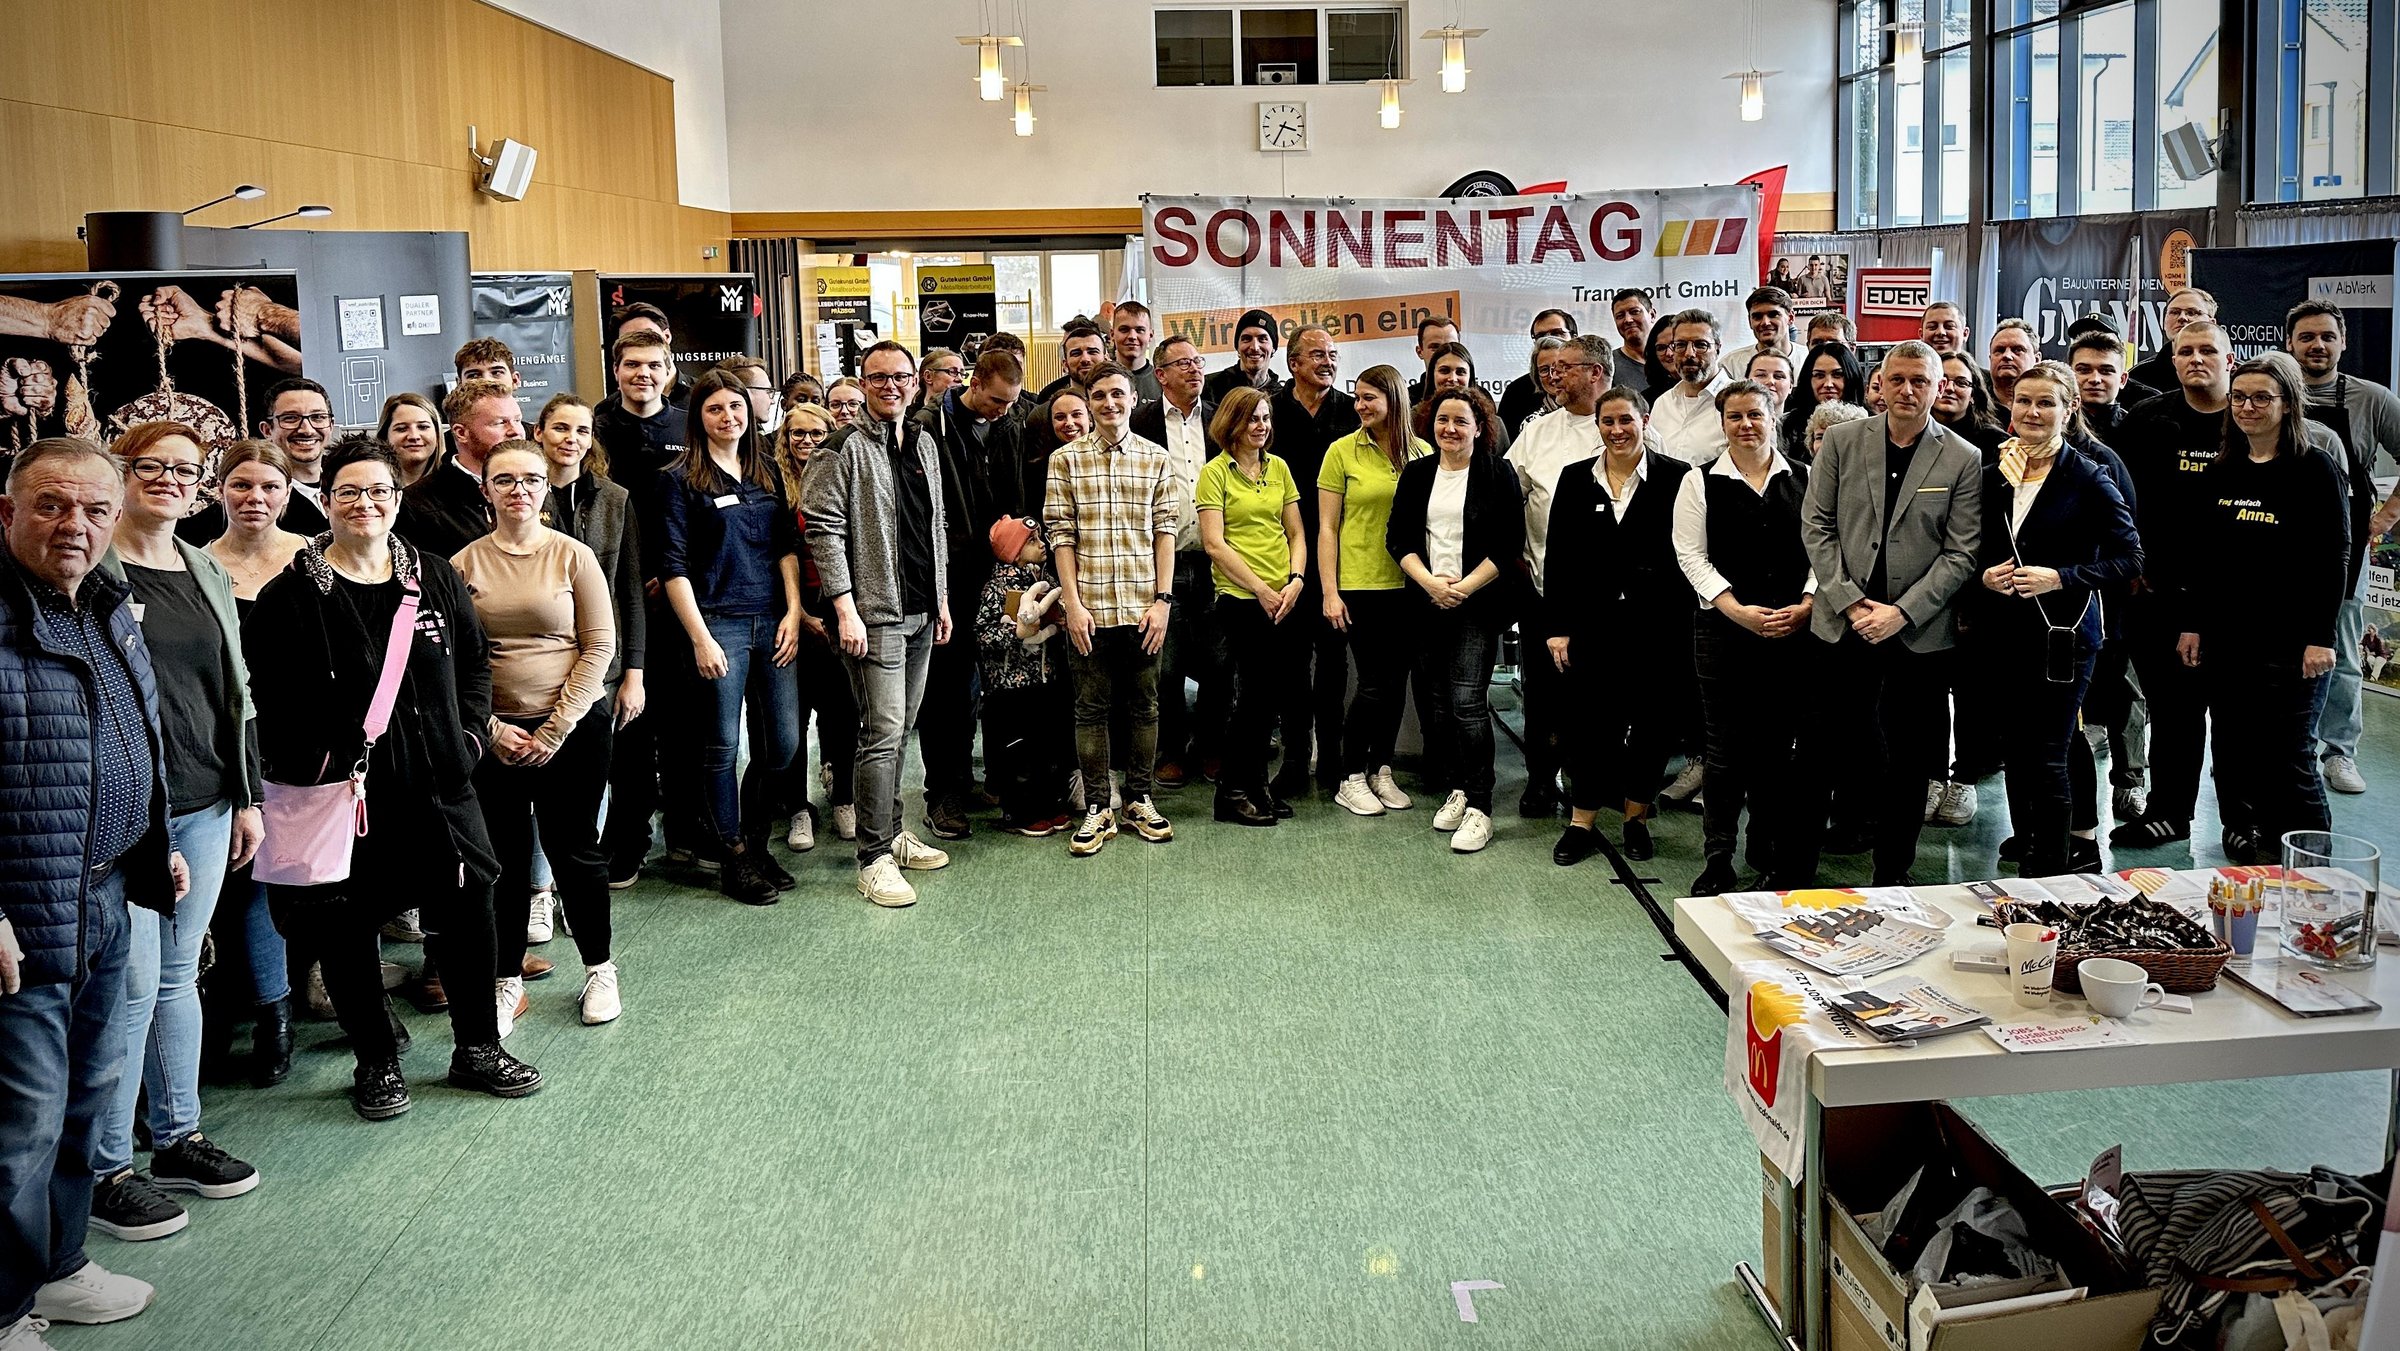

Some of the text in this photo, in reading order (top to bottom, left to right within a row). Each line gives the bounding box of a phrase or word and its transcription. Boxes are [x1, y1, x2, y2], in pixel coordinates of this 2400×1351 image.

[1152, 201, 1642, 269] SONNENTAG
[1572, 279, 1738, 302] Tranort GmbH
[2062, 277, 2164, 290] BAUUNTERNEMEN
[1867, 287, 1928, 305] EDER
[1170, 315, 1234, 348] Wir
[2230, 325, 2283, 341] SORGEN
[2234, 499, 2262, 507] einfach
[2236, 508, 2279, 525] Anna.
[2368, 570, 2389, 583] lfen
[2381, 594, 2400, 608] jetz
